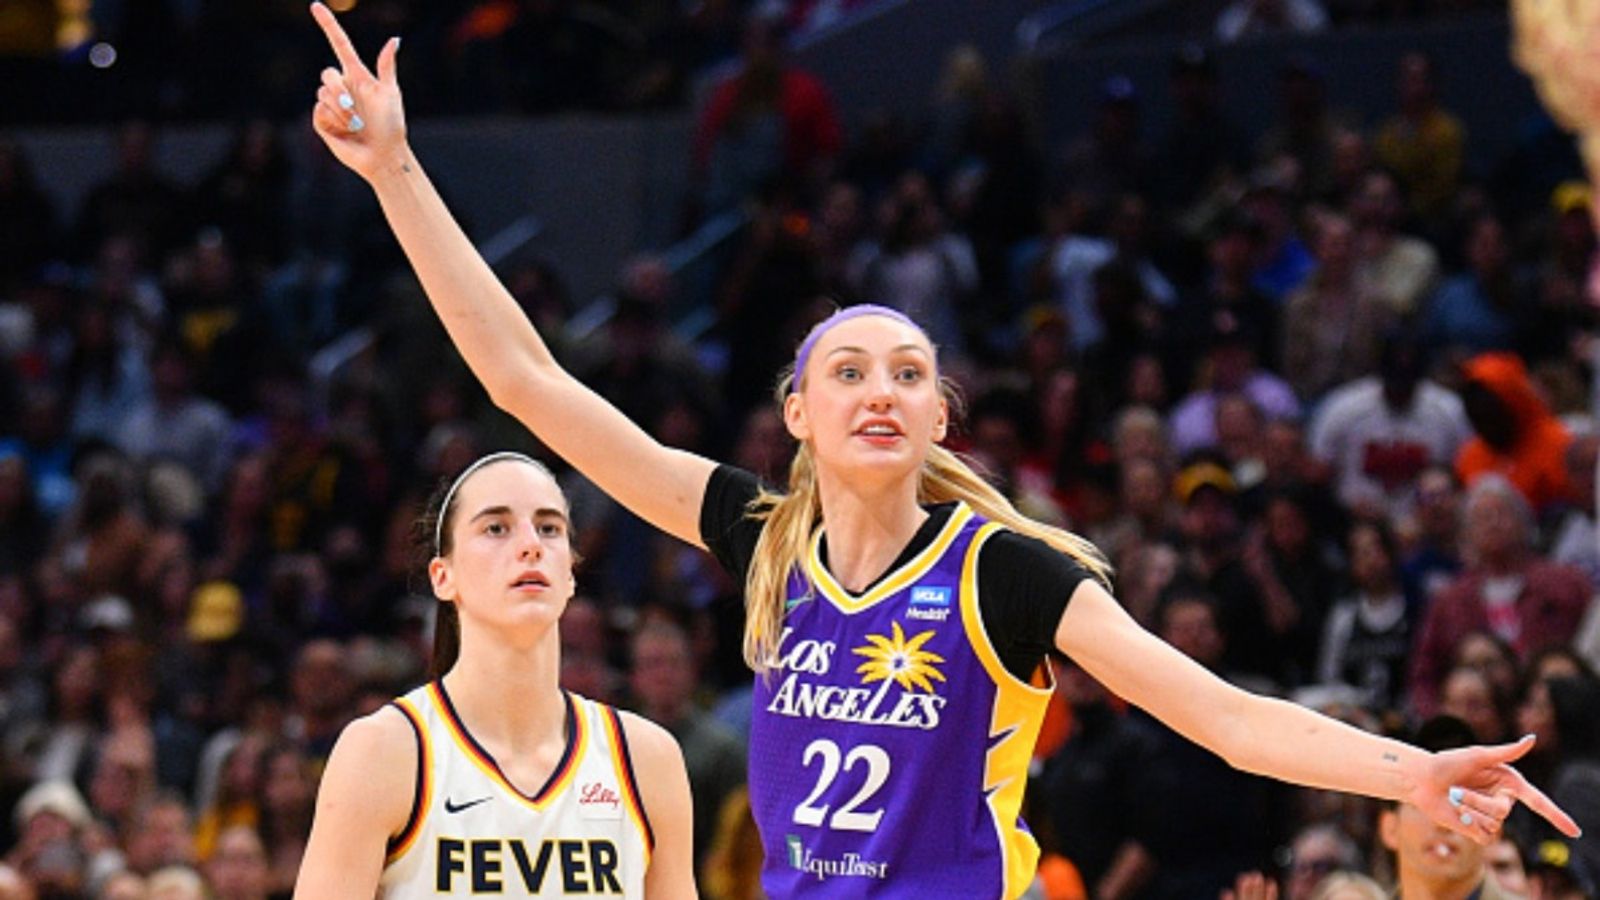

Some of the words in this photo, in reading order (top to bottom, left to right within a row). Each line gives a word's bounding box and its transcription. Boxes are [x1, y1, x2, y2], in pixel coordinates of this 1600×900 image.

[905, 607, 947, 621] Health
[913, 590, 944, 602] UCLA
[768, 673, 947, 730] ANGELES
[580, 782, 621, 809] Lilly
[792, 738, 890, 832] 22
[435, 836, 624, 895] FEVER
